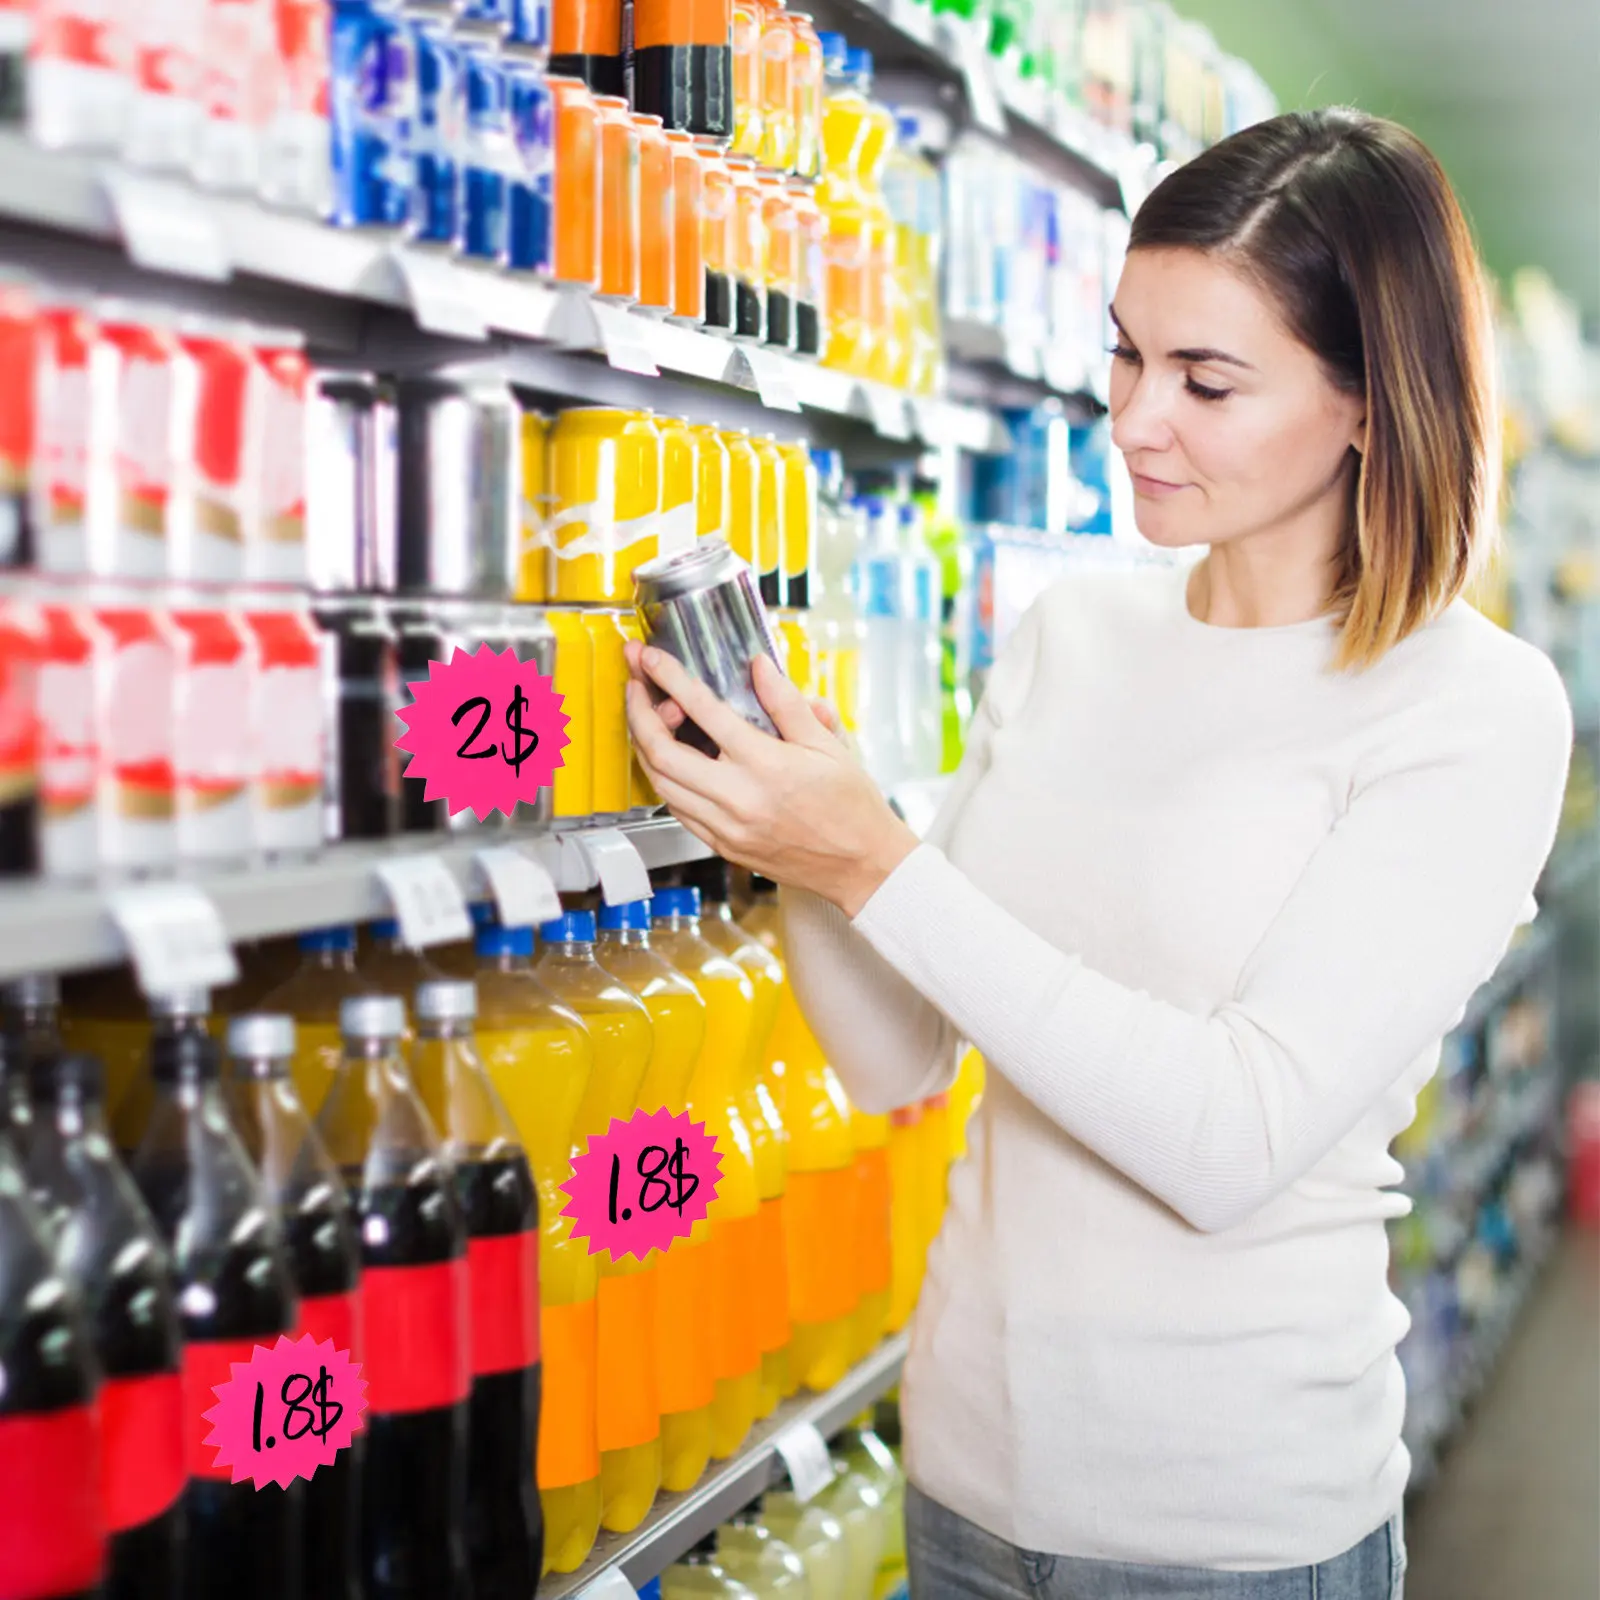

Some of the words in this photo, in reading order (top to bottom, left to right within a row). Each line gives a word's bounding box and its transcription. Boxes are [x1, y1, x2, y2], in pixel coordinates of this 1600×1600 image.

[452, 685, 538, 777] 2$
[609, 1138, 699, 1224] 1.8$
[253, 1366, 343, 1452] 1.8$
